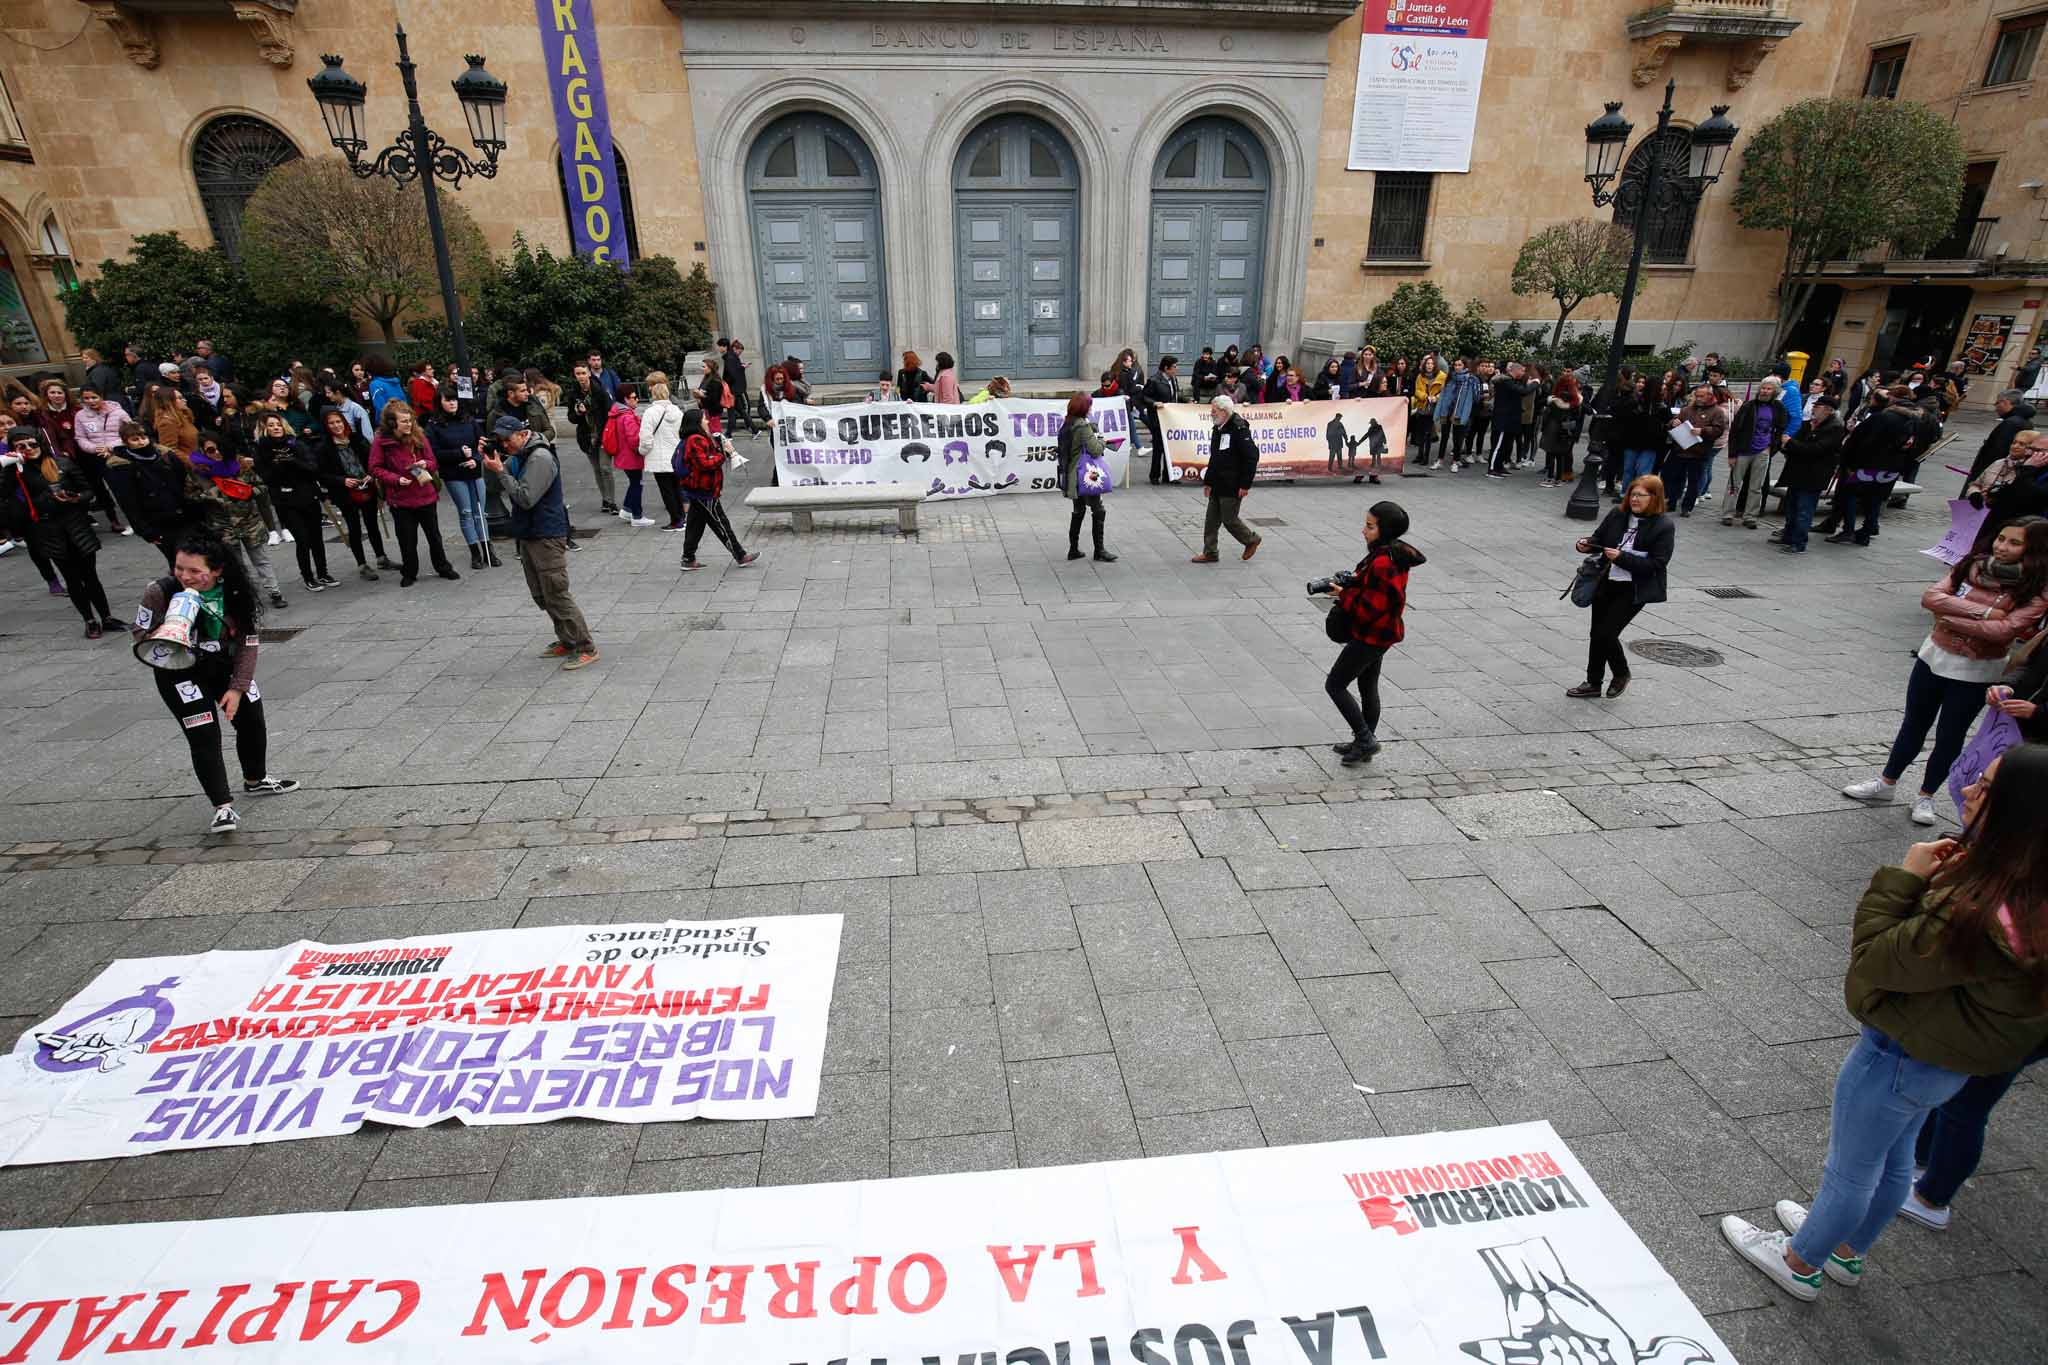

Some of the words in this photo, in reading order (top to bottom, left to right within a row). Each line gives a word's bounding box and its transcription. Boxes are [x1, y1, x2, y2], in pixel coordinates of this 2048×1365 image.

[1406, 15, 1438, 25] Castilla
[1440, 18, 1445, 27] y
[1447, 16, 1468, 26] León
[1407, 2, 1432, 13] Junta
[1435, 4, 1446, 13] de
[871, 24, 979, 49] BANCO
[1000, 31, 1031, 50] DE
[1052, 26, 1169, 53] ESPAÑA
[838, 413, 999, 444] QUEREMOS
[1167, 429, 1205, 441] CONTRA
[1263, 428, 1275, 439] DE
[1279, 424, 1317, 439] GÉNERO
[1242, 411, 1283, 421] SALAMANCA
[787, 448, 872, 465] LIBERTAD
[586, 926, 759, 943] Estudiantes
[627, 940, 770, 960] Sindicato
[298, 946, 452, 963] REVOLUCIONARIA
[321, 956, 445, 976] IZQUIERDA
[586, 947, 621, 964] de
[247, 964, 631, 1012] ANTICAPITALISTA
[632, 963, 655, 991] Y
[541, 984, 771, 1021] FEMINISMO
[509, 1030, 548, 1061] Y
[562, 1016, 776, 1061] LIBRES
[135, 1026, 511, 1094] COMBATIVAS
[342, 1061, 663, 1123] QUEREMOS
[672, 1059, 793, 1105] NOS
[128, 1087, 324, 1142] VIVAS
[1343, 1151, 1564, 1199] REVOLUCIONARIA
[1404, 1174, 1590, 1228] IZQUIERDA
[986, 1240, 1105, 1302] LA
[1171, 1226, 1228, 1284] Y
[461, 1252, 947, 1344] OPRESIÓN
[0, 1279, 420, 1364] CAPITAL
[1280, 1305, 1388, 1365] LA
